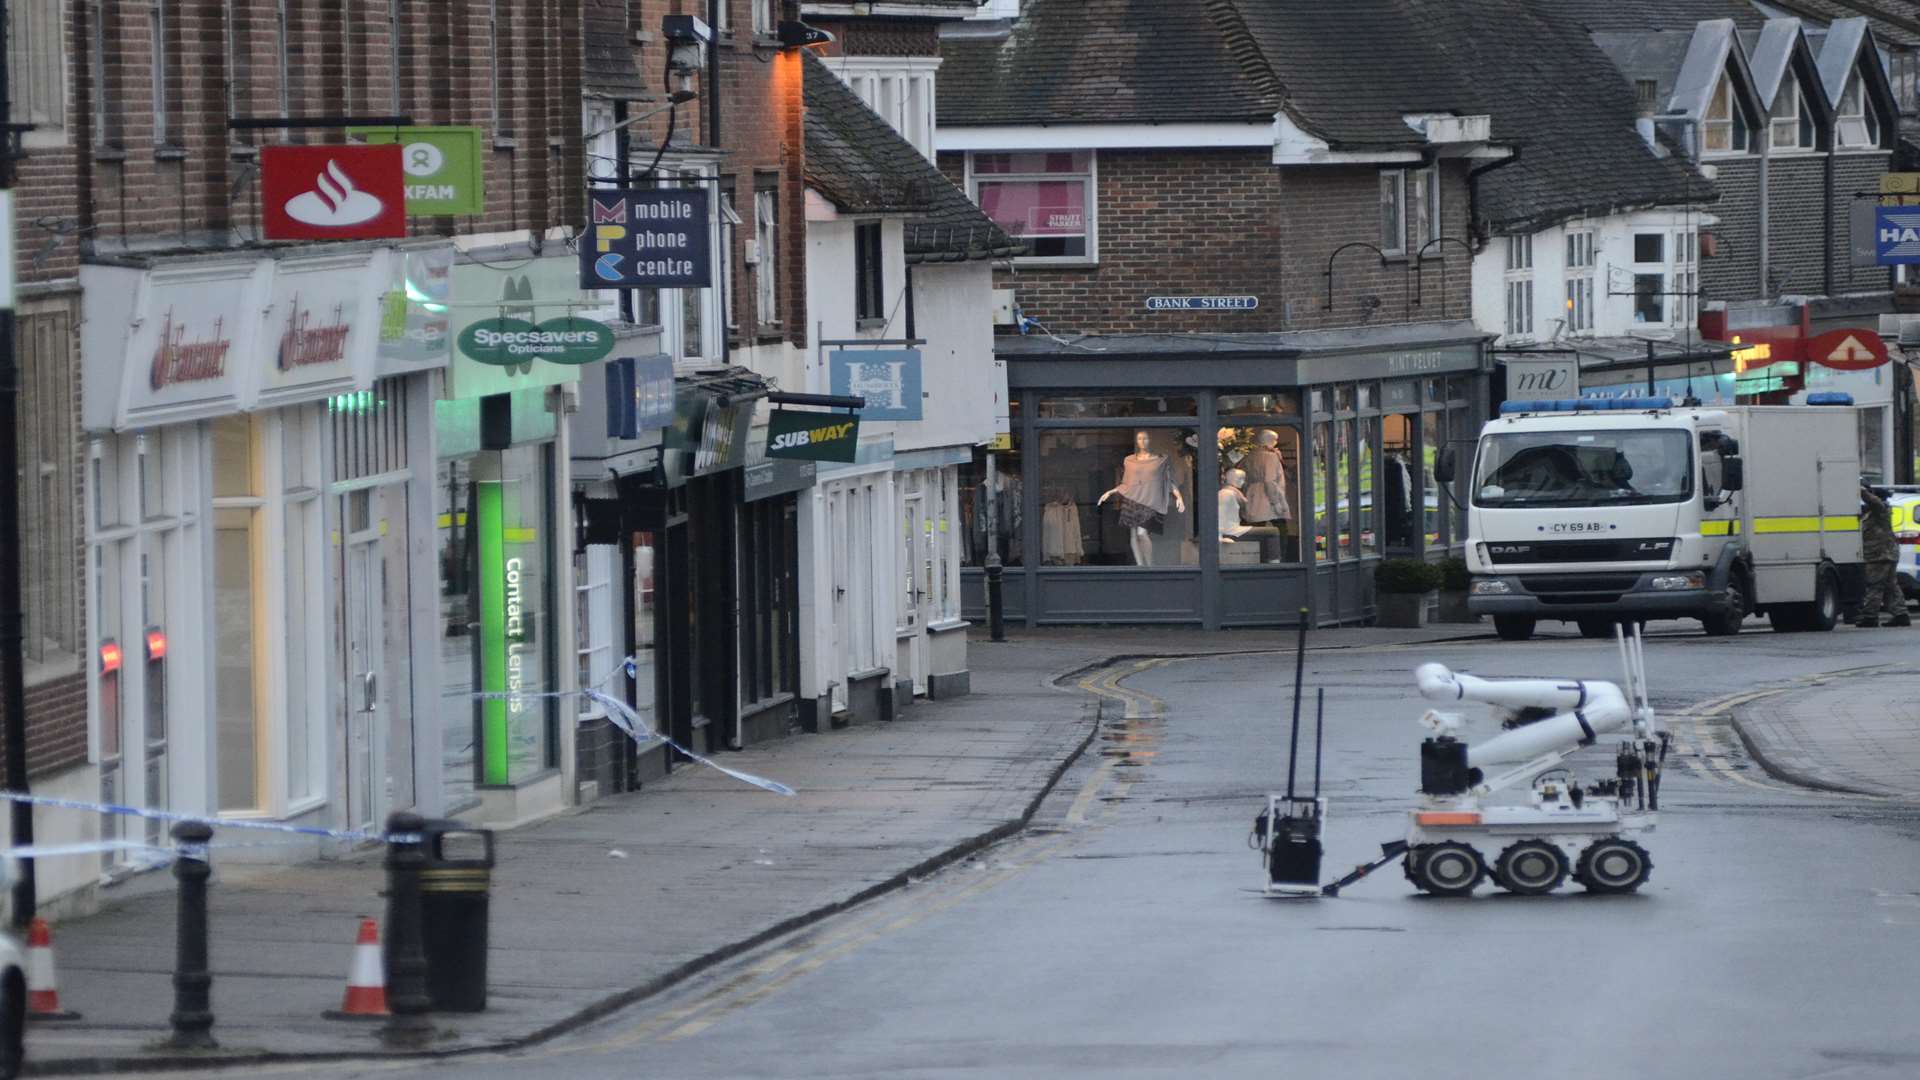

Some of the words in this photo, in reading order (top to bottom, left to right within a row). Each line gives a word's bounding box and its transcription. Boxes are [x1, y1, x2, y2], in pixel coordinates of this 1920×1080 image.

[403, 184, 455, 200] XFAM
[635, 200, 692, 219] mobile
[636, 230, 687, 251] phone
[636, 257, 693, 276] centre
[1154, 298, 1191, 308] BANK
[1201, 298, 1249, 308] STREET
[474, 329, 599, 347] Specsavers
[508, 344, 565, 355] Opticians
[770, 422, 855, 450] SUBWAY
[1569, 522, 1584, 532] 69
[1490, 545, 1531, 554] DAF
[506, 558, 522, 638] Contact
